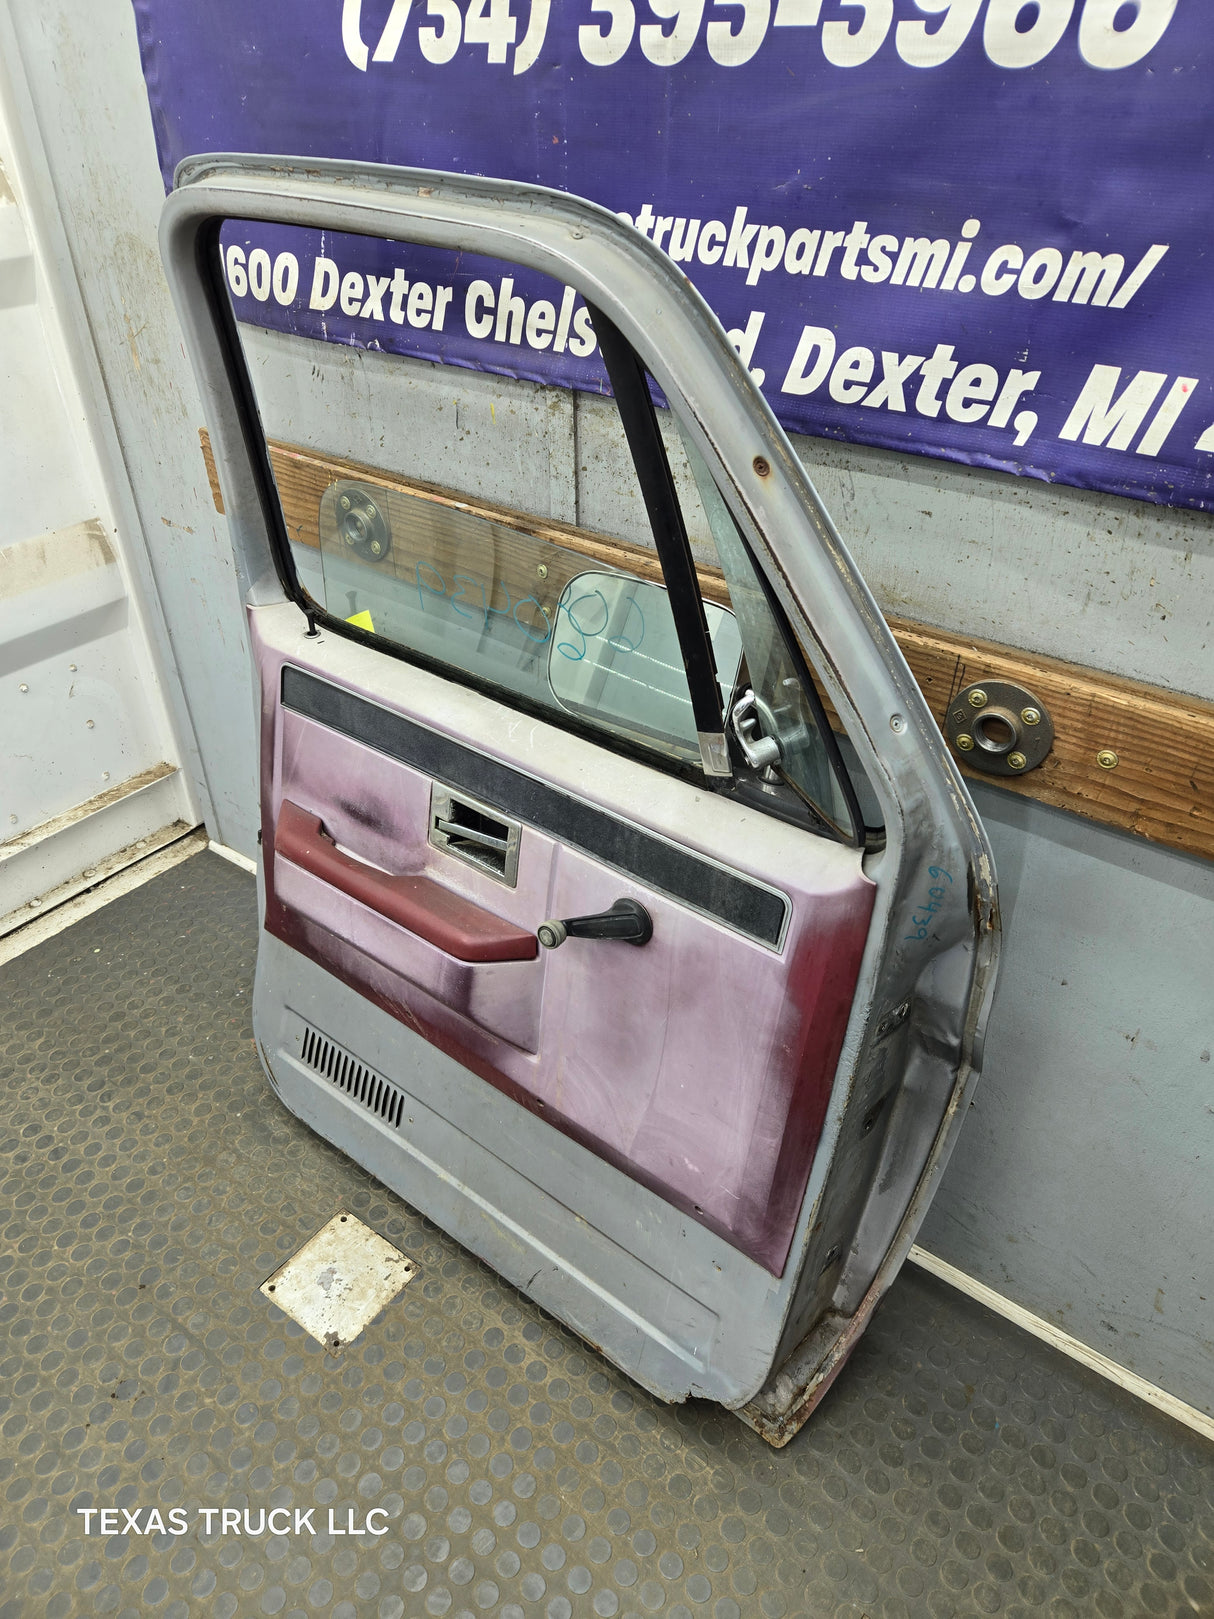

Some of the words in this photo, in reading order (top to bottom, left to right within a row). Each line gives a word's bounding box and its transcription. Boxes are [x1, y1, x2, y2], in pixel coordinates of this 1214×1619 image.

[341, 0, 550, 76] (734)
[616, 204, 1170, 309] truckpartsmi.com/
[219, 244, 299, 306] 600
[309, 257, 453, 331] Dexter
[465, 277, 604, 357] Chels
[781, 325, 1041, 446] Dexter,
[1058, 364, 1199, 456] MI
[904, 866, 953, 941] 60439
